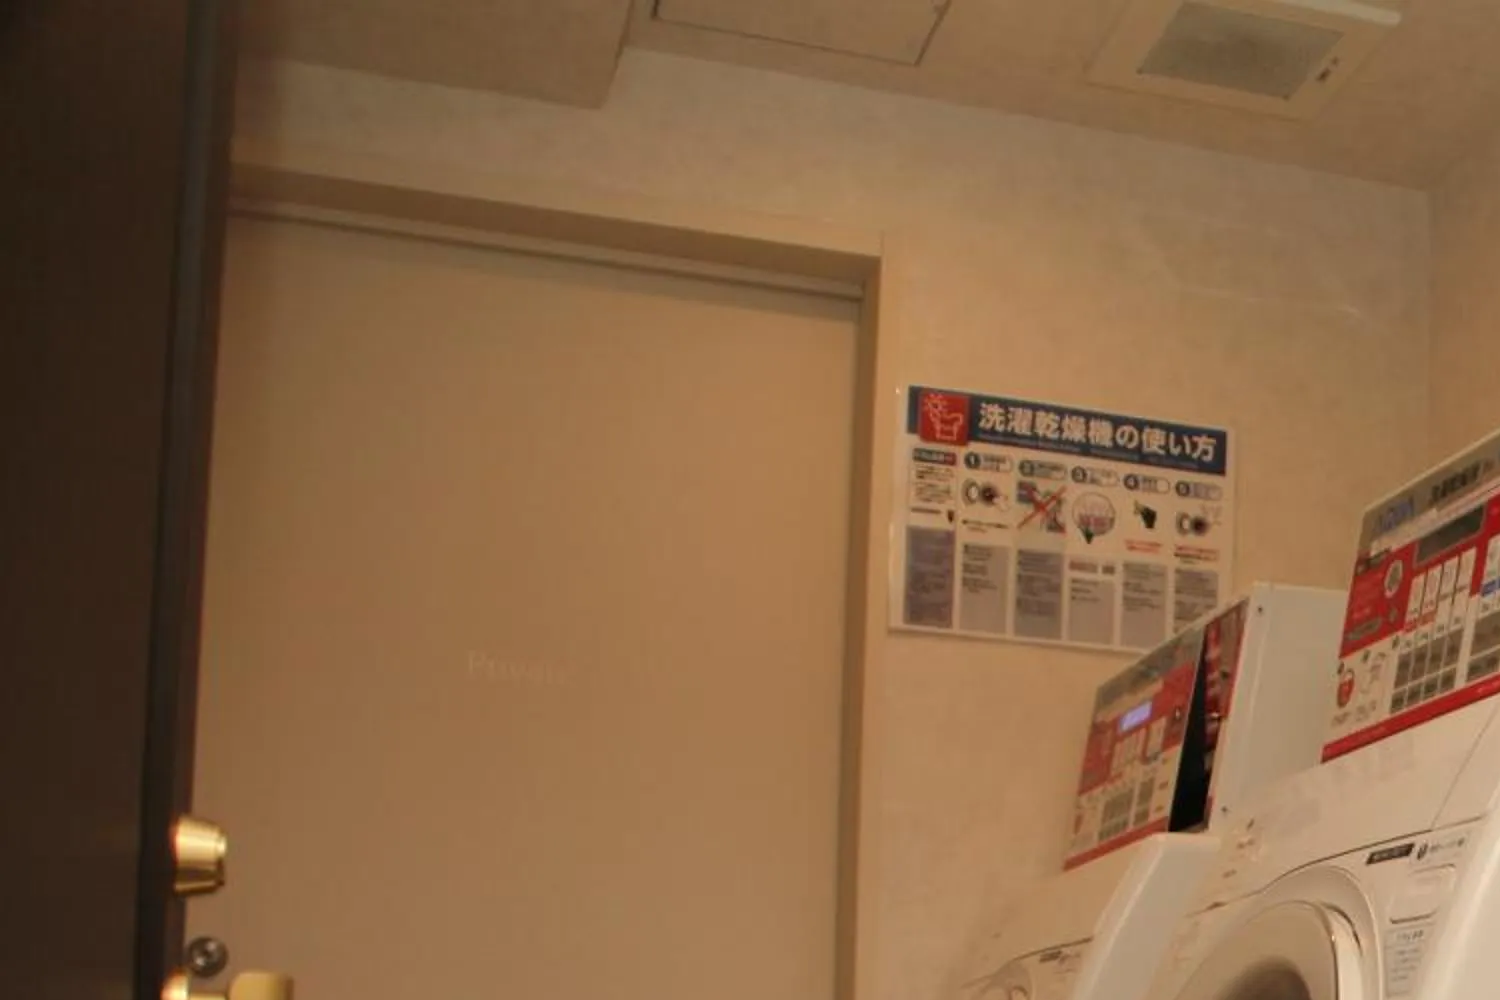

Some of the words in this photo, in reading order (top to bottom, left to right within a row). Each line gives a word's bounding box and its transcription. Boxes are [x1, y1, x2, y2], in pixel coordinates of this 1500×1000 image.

[978, 402, 1217, 462] 洗濯乾燥機の使い方
